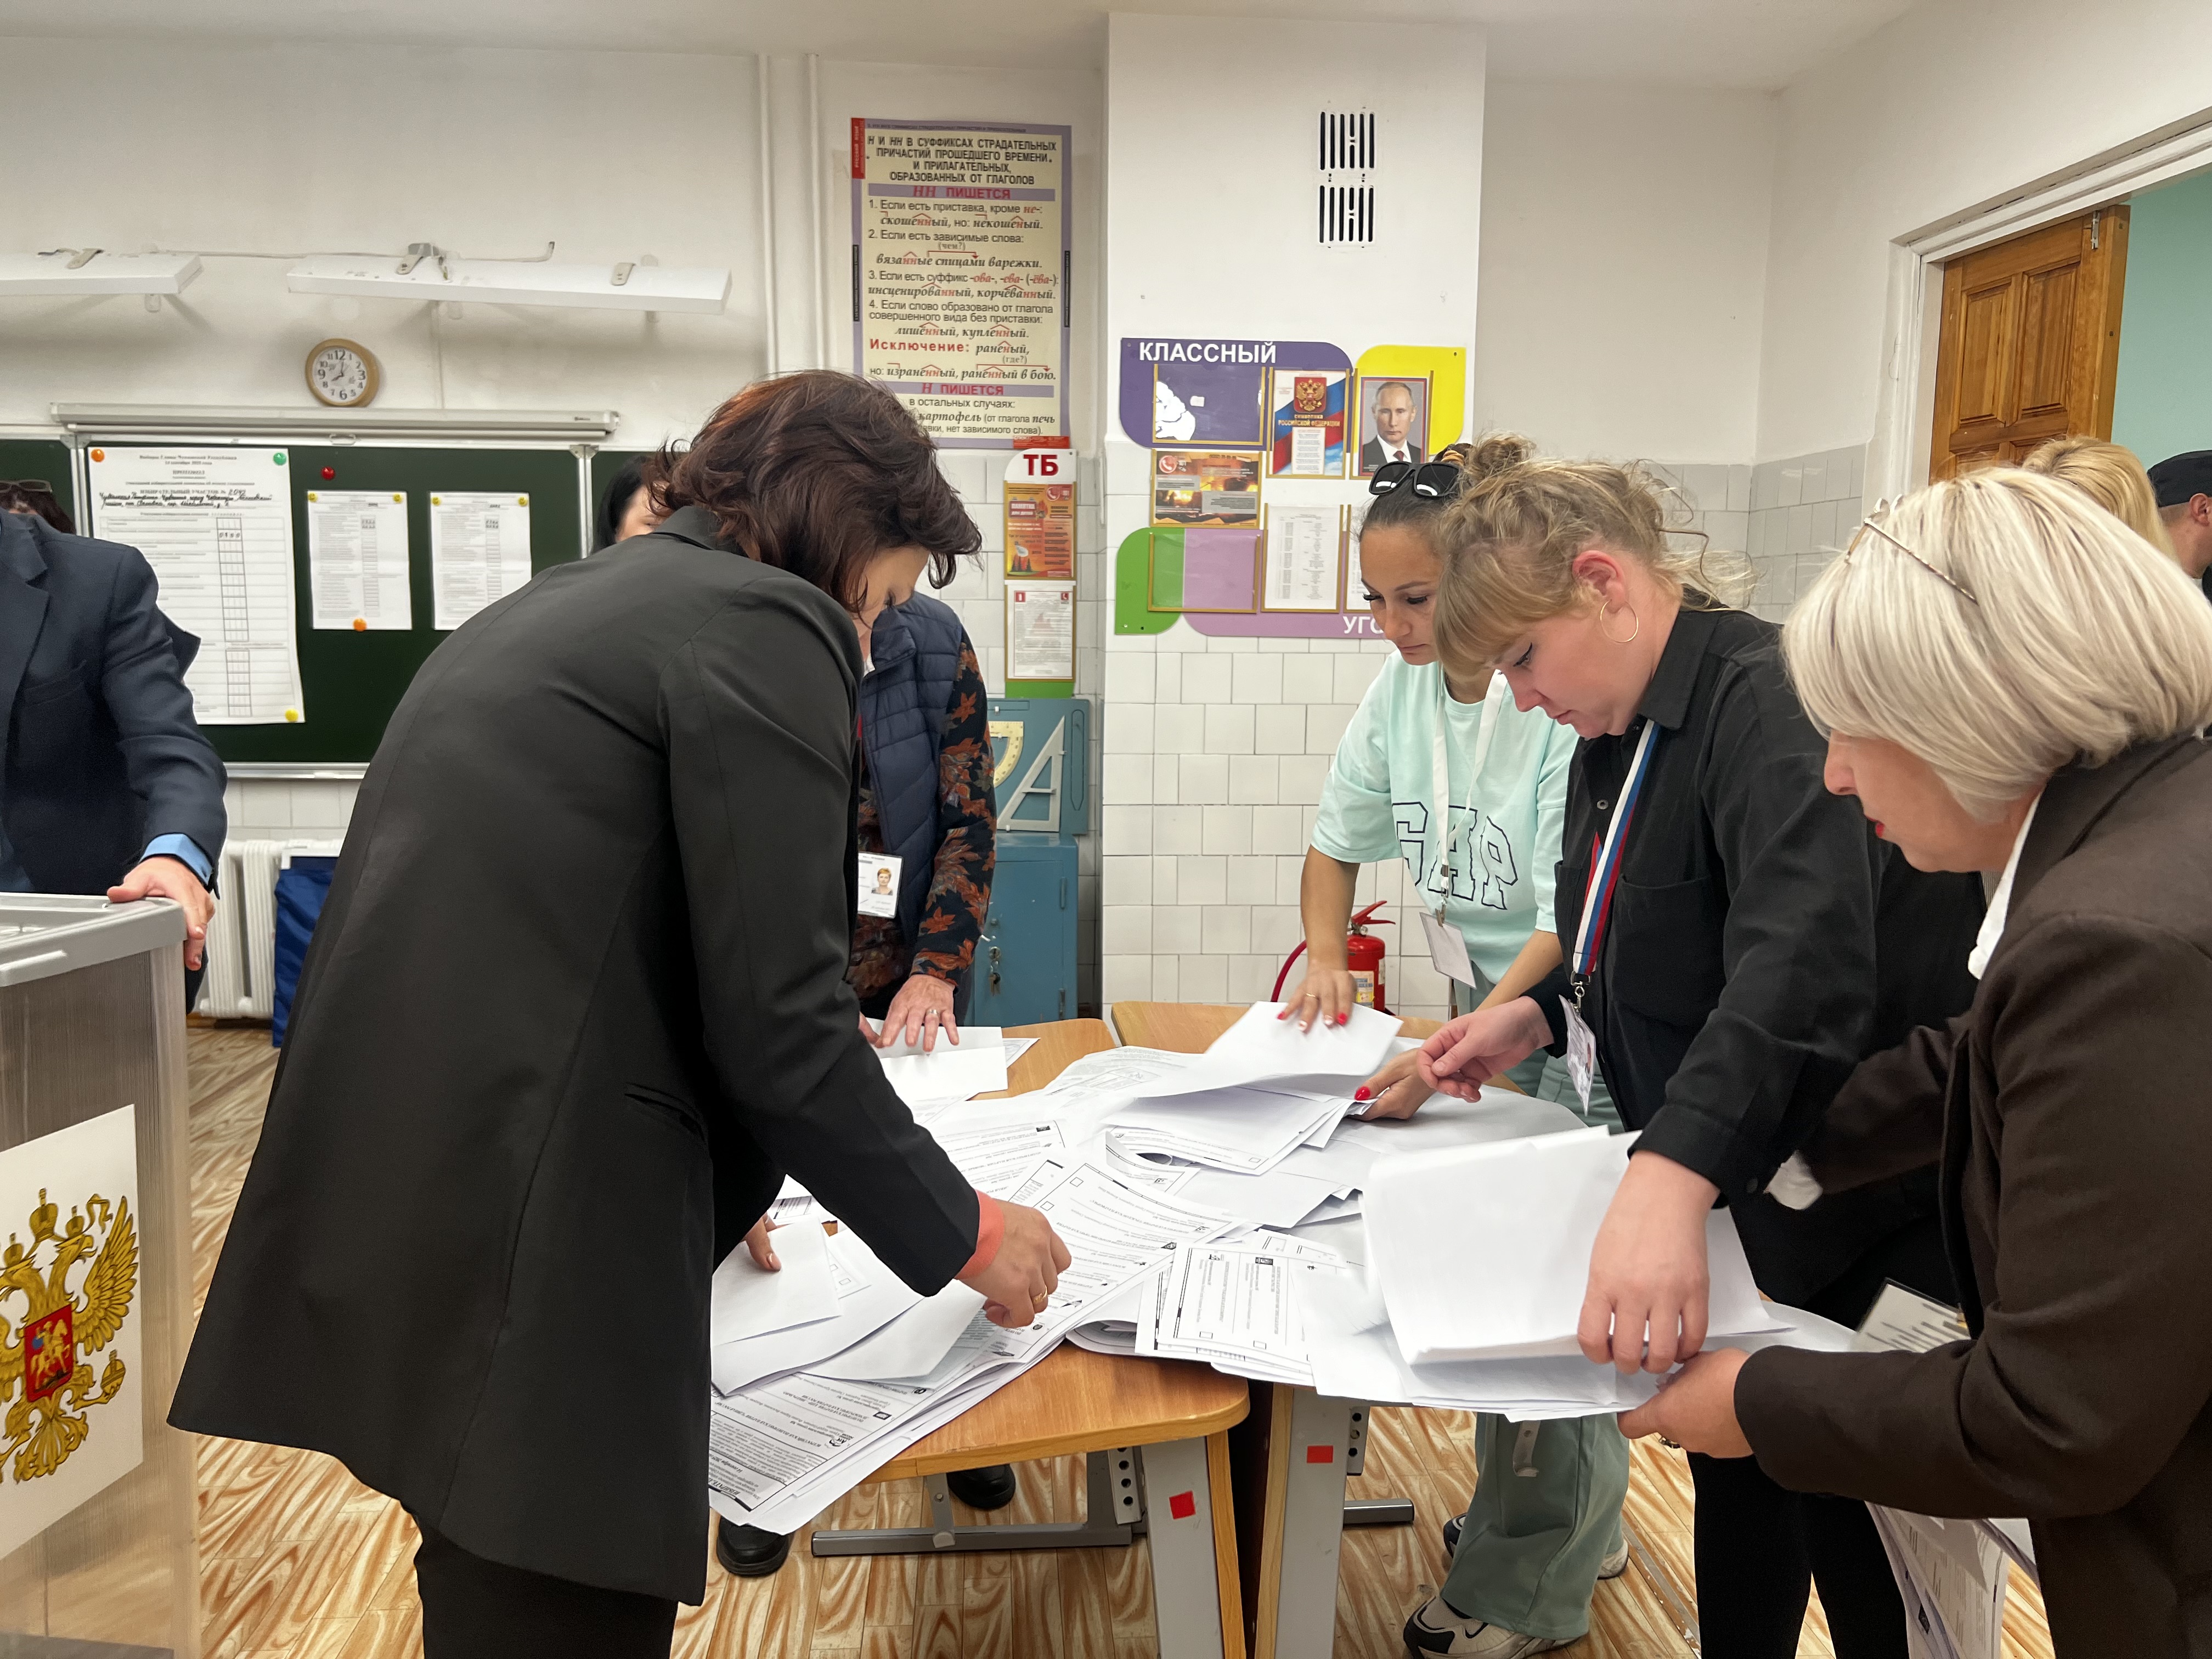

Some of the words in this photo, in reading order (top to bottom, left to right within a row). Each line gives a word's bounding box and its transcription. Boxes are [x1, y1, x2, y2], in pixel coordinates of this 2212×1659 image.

[867, 136, 875, 144] Н
[879, 137, 885, 145] И
[890, 137, 903, 146] НН
[906, 138, 913, 146] В
[917, 138, 973, 148] СУФФИКСАХ
[978, 139, 1057, 150] СТРАДАТЕЛЬНЫХ
[876, 148, 931, 159] ПРИЧАСТИЙ
[935, 150, 1000, 160] ПРОШЕДШЕГО
[913, 161, 919, 170] И
[924, 161, 1011, 173] ПРИЛАГАТЕЛЬНЫХ,
[890, 172, 966, 182] ОБРАЗОВАННЫХ
[970, 174, 982, 183] ОТ
[986, 174, 1035, 184] ГЛАГОЛОВ
[913, 186, 936, 198] НН
[946, 187, 1011, 199] ПИШЕТСЯ
[869, 199, 877, 208] 1.
[880, 200, 905, 210] Если
[933, 204, 987, 213] приставка,
[990, 205, 1020, 215] кроме
[880, 217, 951, 228] скошенный,
[973, 219, 1043, 229] некошеный.
[868, 229, 877, 239] 2.
[881, 230, 905, 239] Если
[933, 234, 989, 242] зависимые
[938, 242, 966, 251] (чем?)
[876, 253, 933, 266] вязанные
[935, 258, 985, 268] спицами
[988, 257, 1042, 270] варежки.
[868, 270, 877, 279] 3.
[879, 270, 902, 280] Если
[927, 273, 968, 284] суффикс
[868, 286, 974, 298] инсценированный,
[869, 300, 878, 308] 4.
[881, 300, 906, 309] Если
[941, 302, 999, 313] образовано
[869, 312, 941, 321] совершенного
[944, 314, 967, 323] вида
[970, 313, 987, 322] без
[990, 315, 1043, 324] приставки:
[962, 329, 1029, 340] купленный.
[870, 338, 969, 352] Исключение:
[975, 344, 1029, 356] раненый,
[1139, 341, 1276, 364] КЛАССНЫЙ
[335, 349, 346, 360] 12
[1002, 356, 1027, 364] (где?)
[318, 369, 325, 380] 9
[358, 370, 365, 380] 3
[887, 368, 958, 379] израненный,
[961, 370, 1017, 381] раненный
[1021, 369, 1027, 379] в
[1030, 370, 1056, 380] бою.
[922, 382, 933, 394] Н
[940, 384, 1004, 395] ПИШЕТСЯ
[340, 390, 347, 400] 6
[918, 399, 970, 407] остальных
[973, 399, 1015, 410] случаях:
[984, 414, 996, 424] (от
[1032, 415, 1055, 424] печь
[1013, 426, 1043, 436] слова).
[1023, 454, 1059, 476] ТБ
